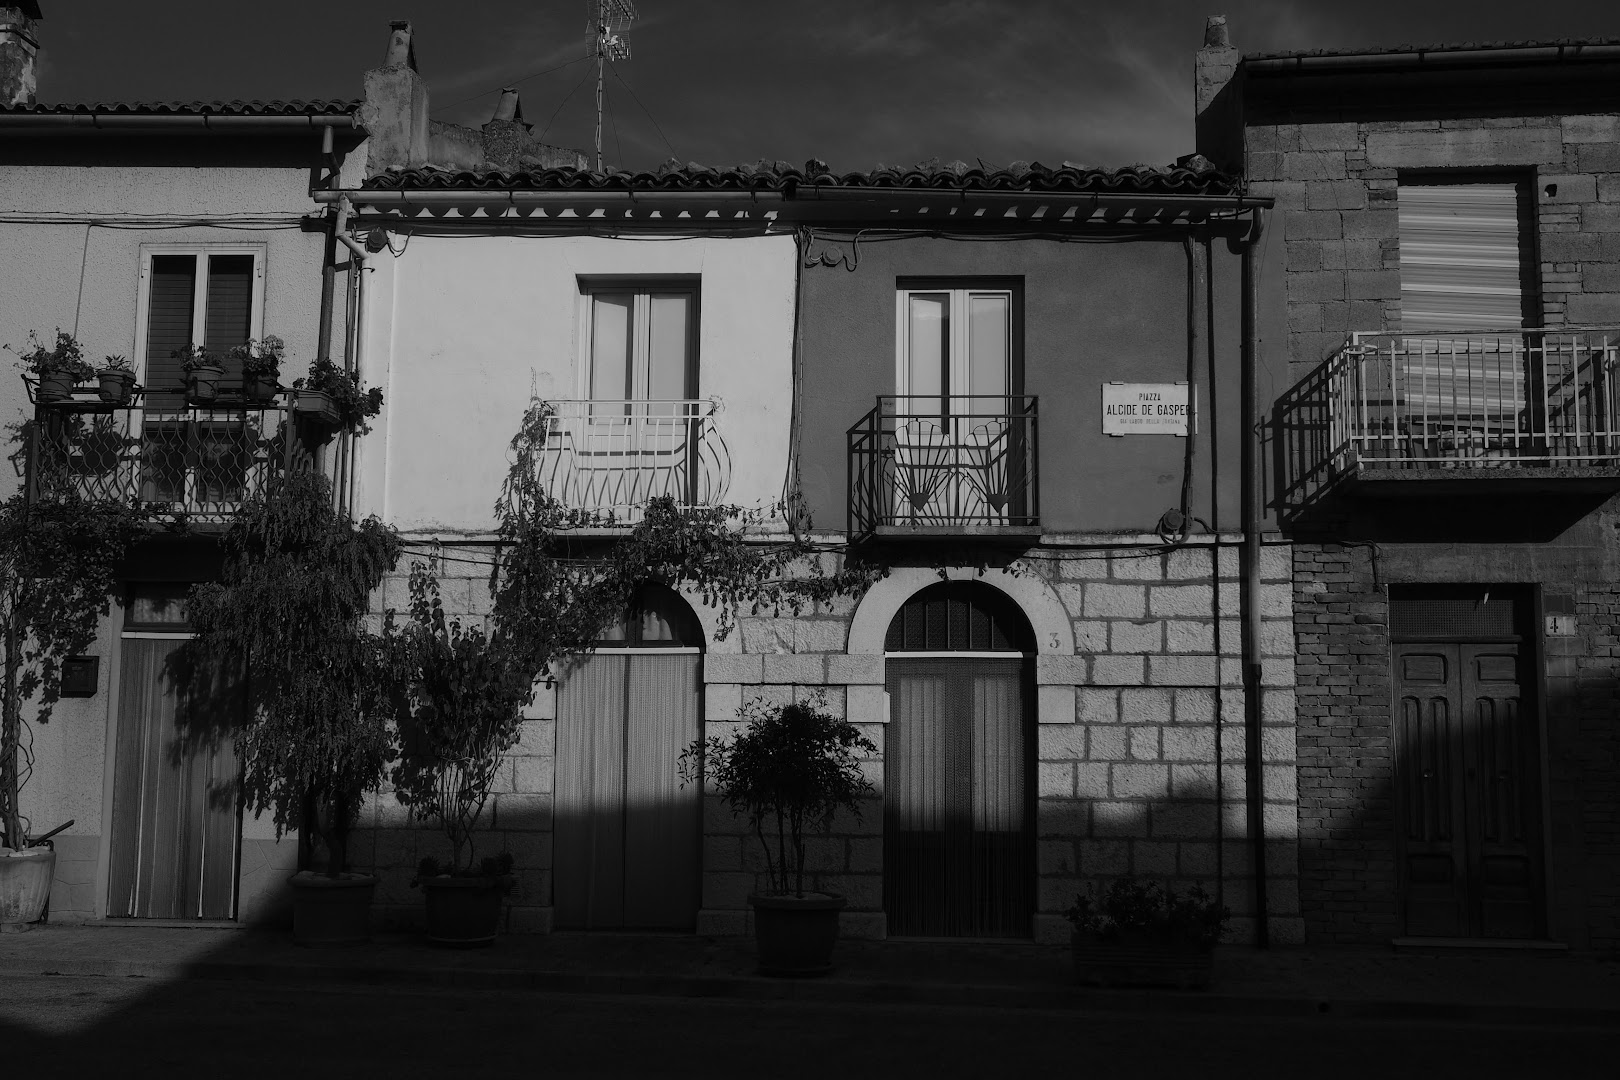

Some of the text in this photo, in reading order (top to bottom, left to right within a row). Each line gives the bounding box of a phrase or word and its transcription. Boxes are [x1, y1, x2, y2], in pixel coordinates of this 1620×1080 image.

[1138, 392, 1161, 401] PIAZZA
[1107, 404, 1191, 416] ALCIDE DE GASPER
[1550, 617, 1559, 633] 4
[1049, 632, 1061, 649] 3
